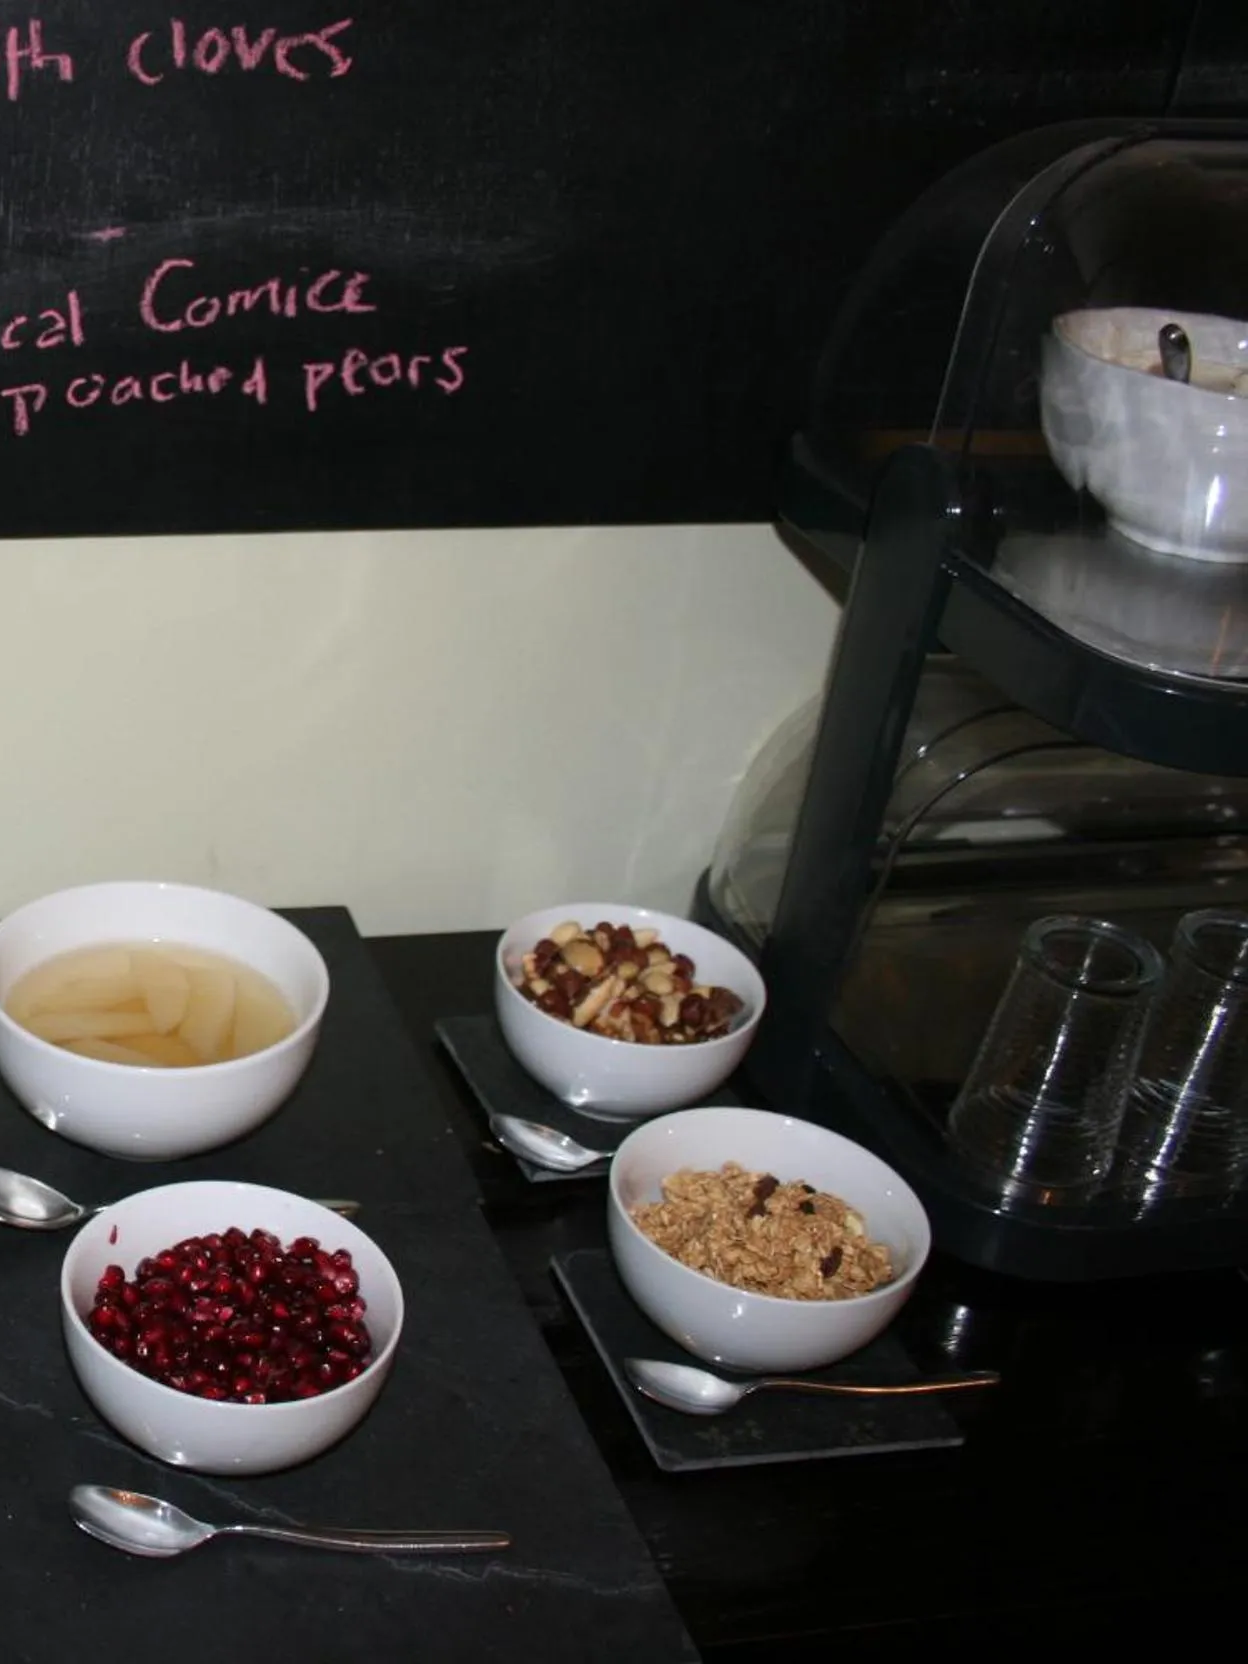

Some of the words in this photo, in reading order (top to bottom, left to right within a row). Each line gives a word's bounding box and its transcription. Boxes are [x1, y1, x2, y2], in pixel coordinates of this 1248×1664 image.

[127, 16, 353, 85] cloves
[140, 258, 377, 332] Comice
[1, 356, 268, 436] poached
[302, 346, 468, 411] pears
